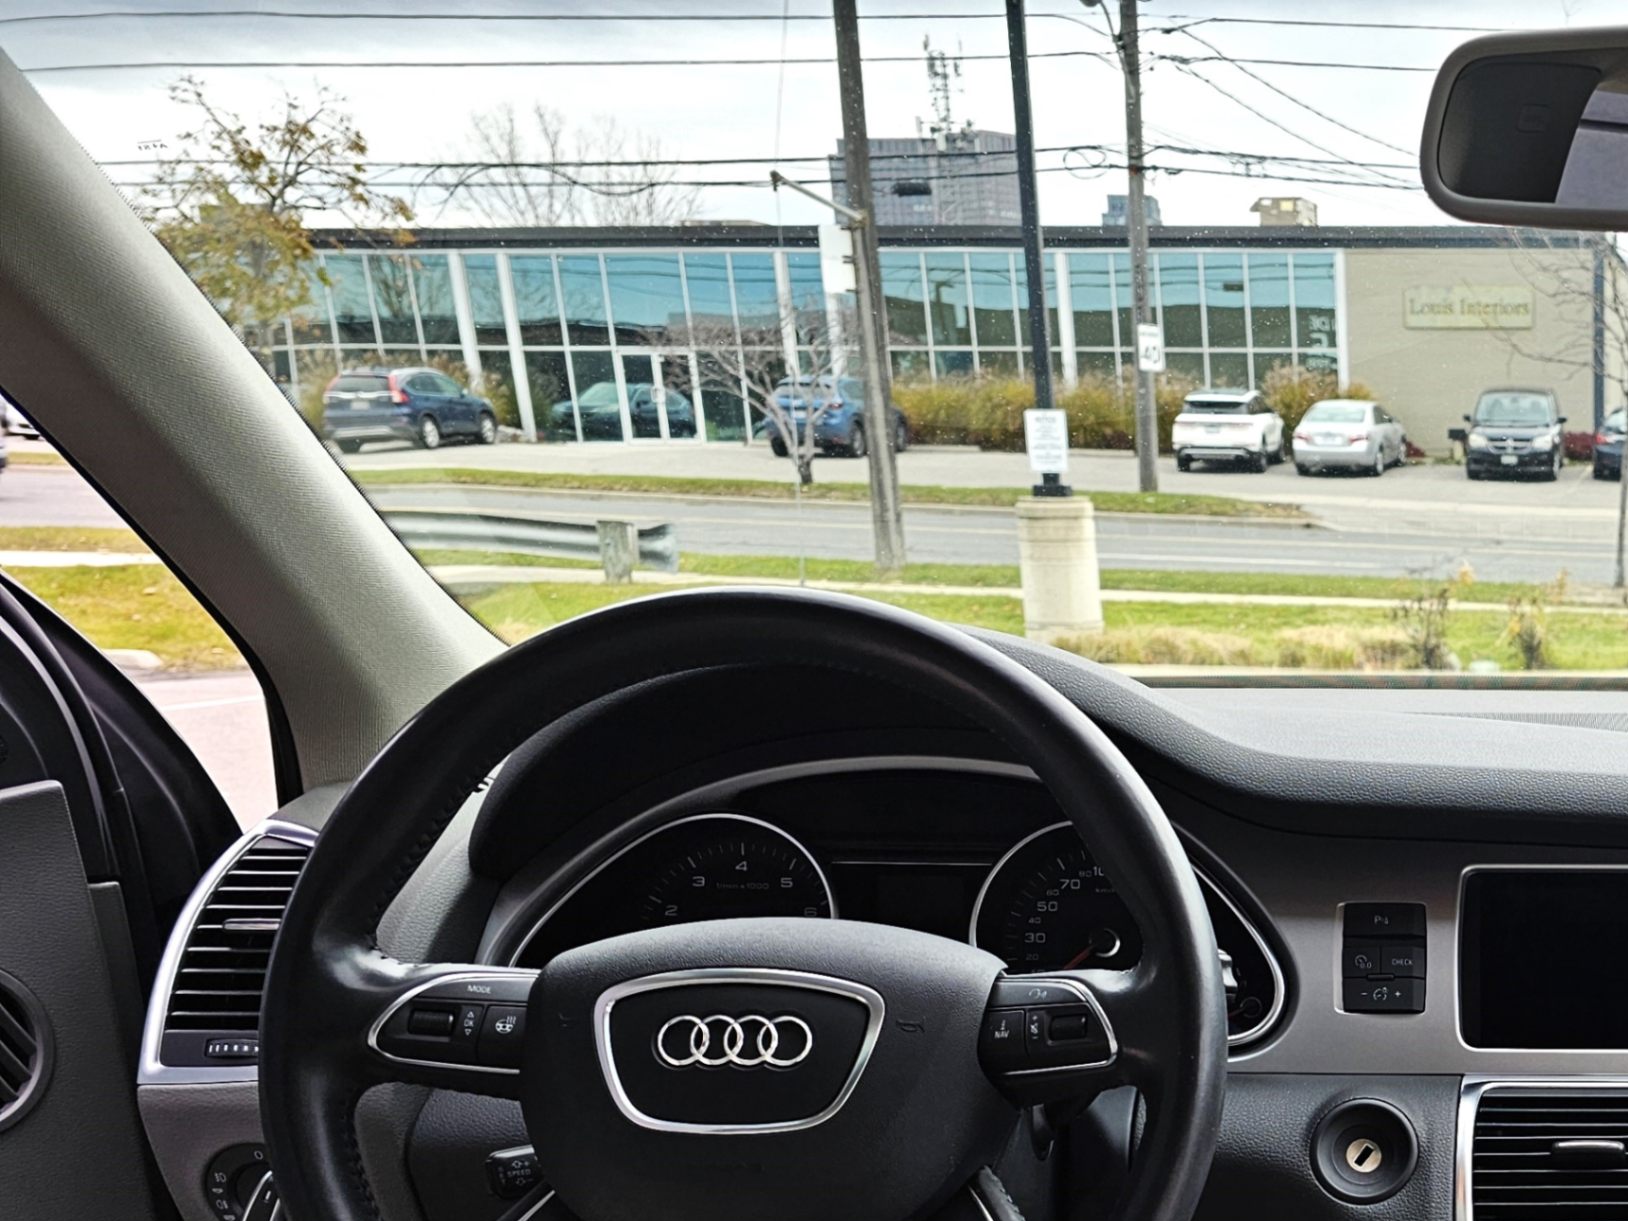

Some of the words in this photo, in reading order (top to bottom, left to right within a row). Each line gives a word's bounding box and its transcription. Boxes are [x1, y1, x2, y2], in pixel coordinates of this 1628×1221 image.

[1409, 299, 1454, 315] Louis
[1459, 299, 1529, 316] Interiors
[735, 861, 748, 871] 4
[692, 876, 705, 887] 3
[781, 877, 793, 888] 5
[1059, 879, 1081, 890] 70
[665, 905, 678, 916] 2
[1037, 901, 1058, 912] 50
[1024, 933, 1046, 943] 30
[467, 984, 491, 994] MODE
[463, 1019, 474, 1027] OK
[994, 1030, 1010, 1038] NAV
[507, 1169, 531, 1178] SPEED
